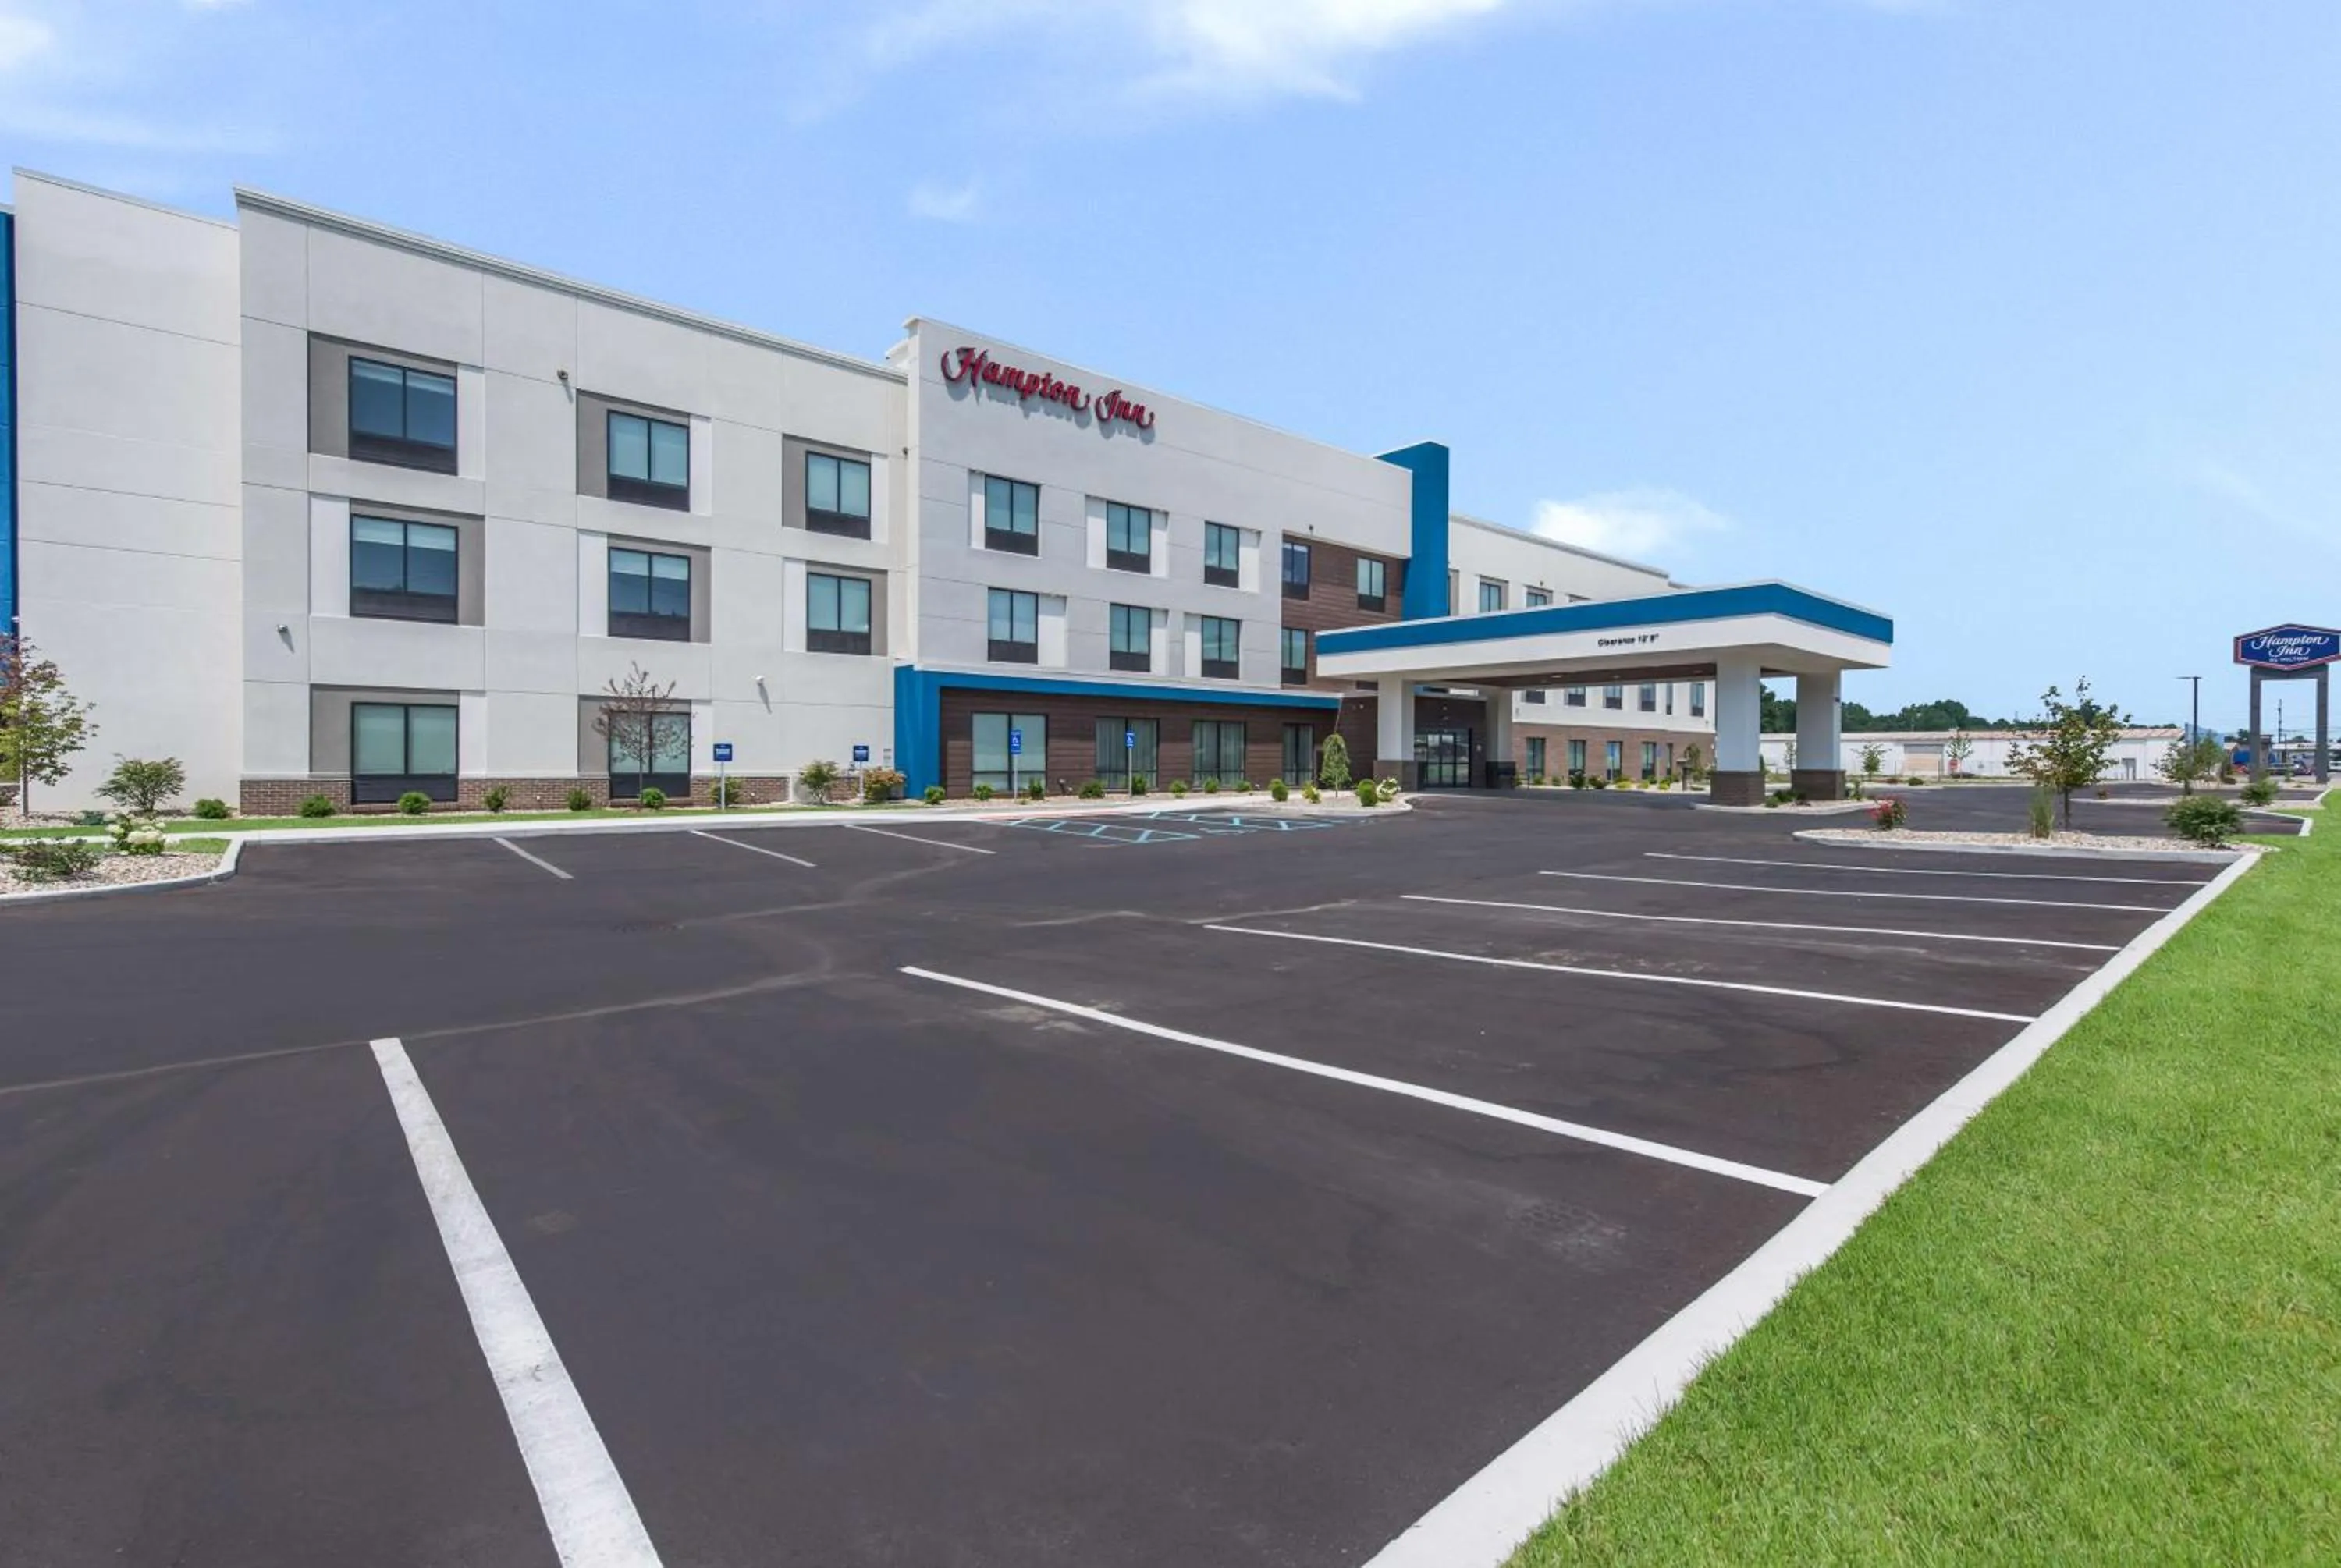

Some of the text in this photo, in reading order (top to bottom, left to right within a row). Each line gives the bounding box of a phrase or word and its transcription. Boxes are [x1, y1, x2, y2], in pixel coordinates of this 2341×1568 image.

[941, 346, 1154, 429] Hampton Inn
[2251, 634, 2329, 650] Hampton
[2268, 646, 2311, 658] Inn
